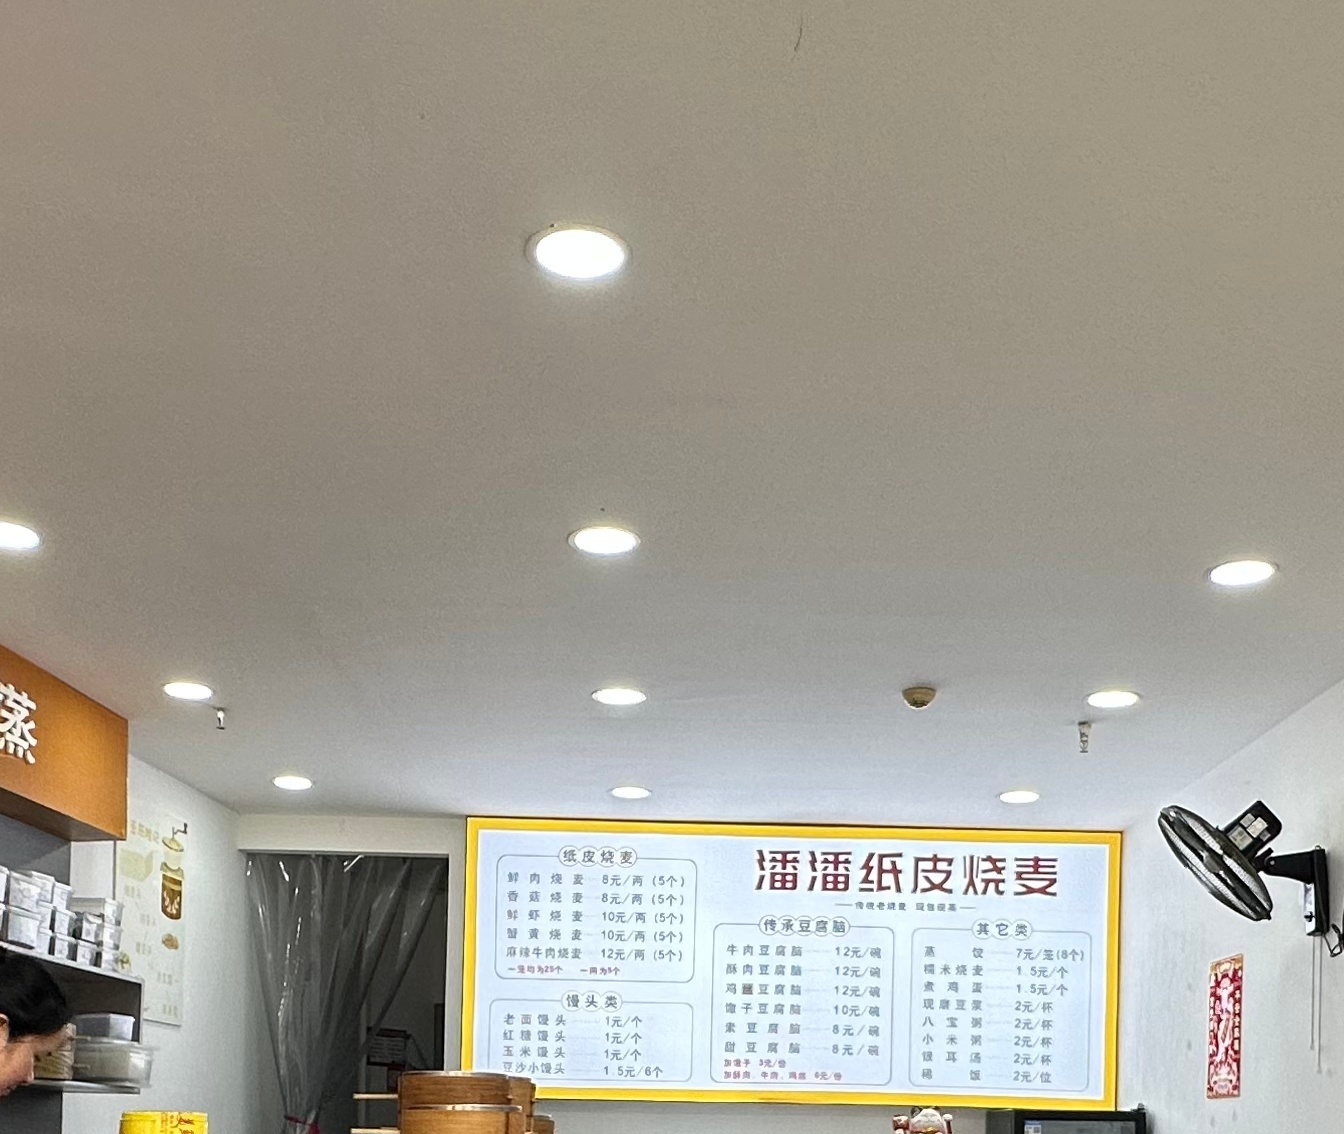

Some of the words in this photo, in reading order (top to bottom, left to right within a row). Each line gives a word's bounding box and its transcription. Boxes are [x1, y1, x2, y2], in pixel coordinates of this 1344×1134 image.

[563, 849, 633, 865] 纸皮烧麦
[507, 872, 584, 886] 鲜肉烧麦
[755, 849, 1058, 897] 潘潘纸皮烧麦
[507, 890, 583, 904] 香菇烧麦
[507, 909, 583, 922] 鲜虾烧麦
[764, 919, 845, 933] 传承豆腐脑
[977, 923, 1028, 937] 其它类
[507, 928, 582, 941] 蟹黄烧麦
[506, 946, 582, 960] 麻辣牛肉烧麦
[726, 944, 803, 957] 牛肉豆腐脑
[923, 963, 983, 976] 糯米烧麦
[566, 994, 617, 1009] 馒头类
[1014, 1001, 1053, 1013] 2元/杯
[503, 1013, 566, 1026] 老面馒头
[605, 1016, 643, 1028] 1元/个
[922, 1017, 982, 1029] 八宝粥
[1014, 1018, 1053, 1031] 2元/杯
[503, 1029, 566, 1042] 红糖馒头
[605, 1032, 642, 1044] 1元/个
[922, 1034, 982, 1046] 小米粥
[1014, 1036, 1052, 1048] 2元/杯
[604, 1048, 642, 1061] 1元/个
[1013, 1053, 1052, 1066] 2元/杯
[503, 1062, 565, 1075] 豆沙小馒头
[1013, 1071, 1052, 1083] 2元/位
